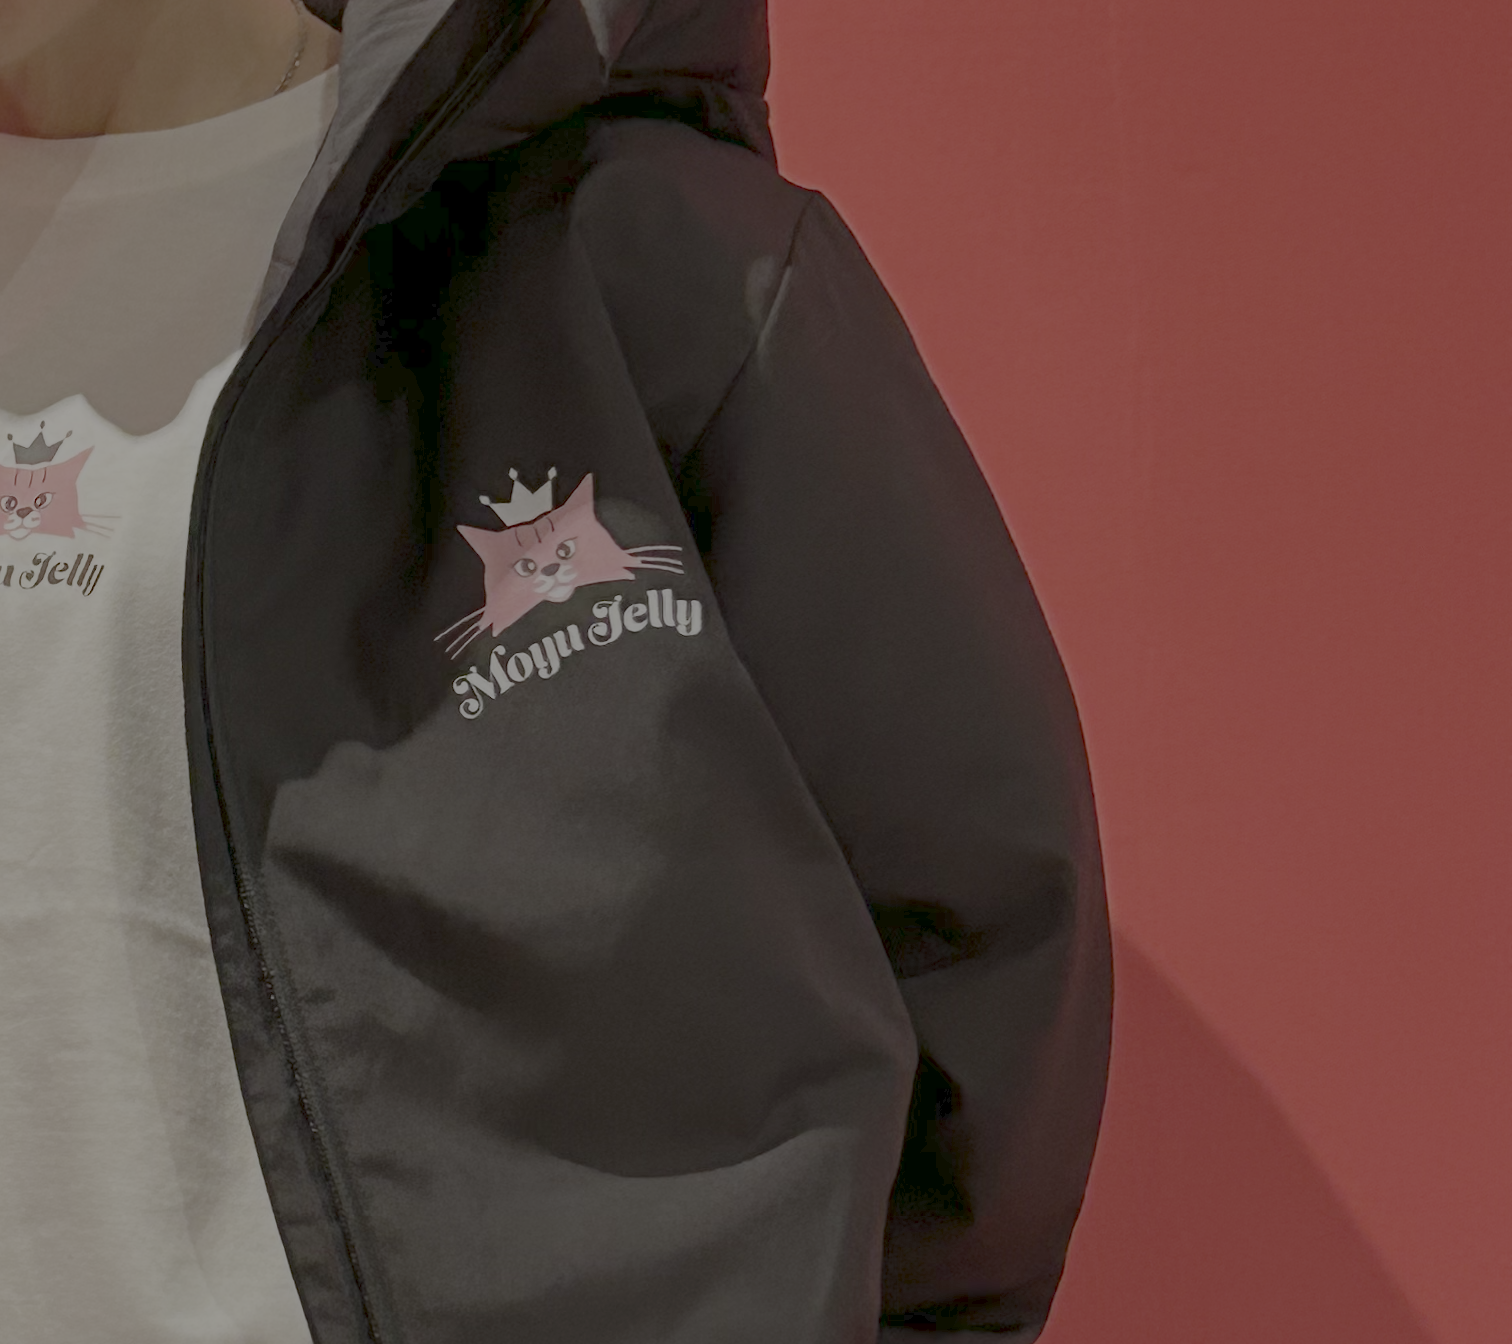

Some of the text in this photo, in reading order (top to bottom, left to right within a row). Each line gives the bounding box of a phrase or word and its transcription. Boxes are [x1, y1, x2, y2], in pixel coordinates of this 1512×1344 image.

[19, 551, 105, 597] Jelly
[452, 588, 703, 720] Moyu Jelly
